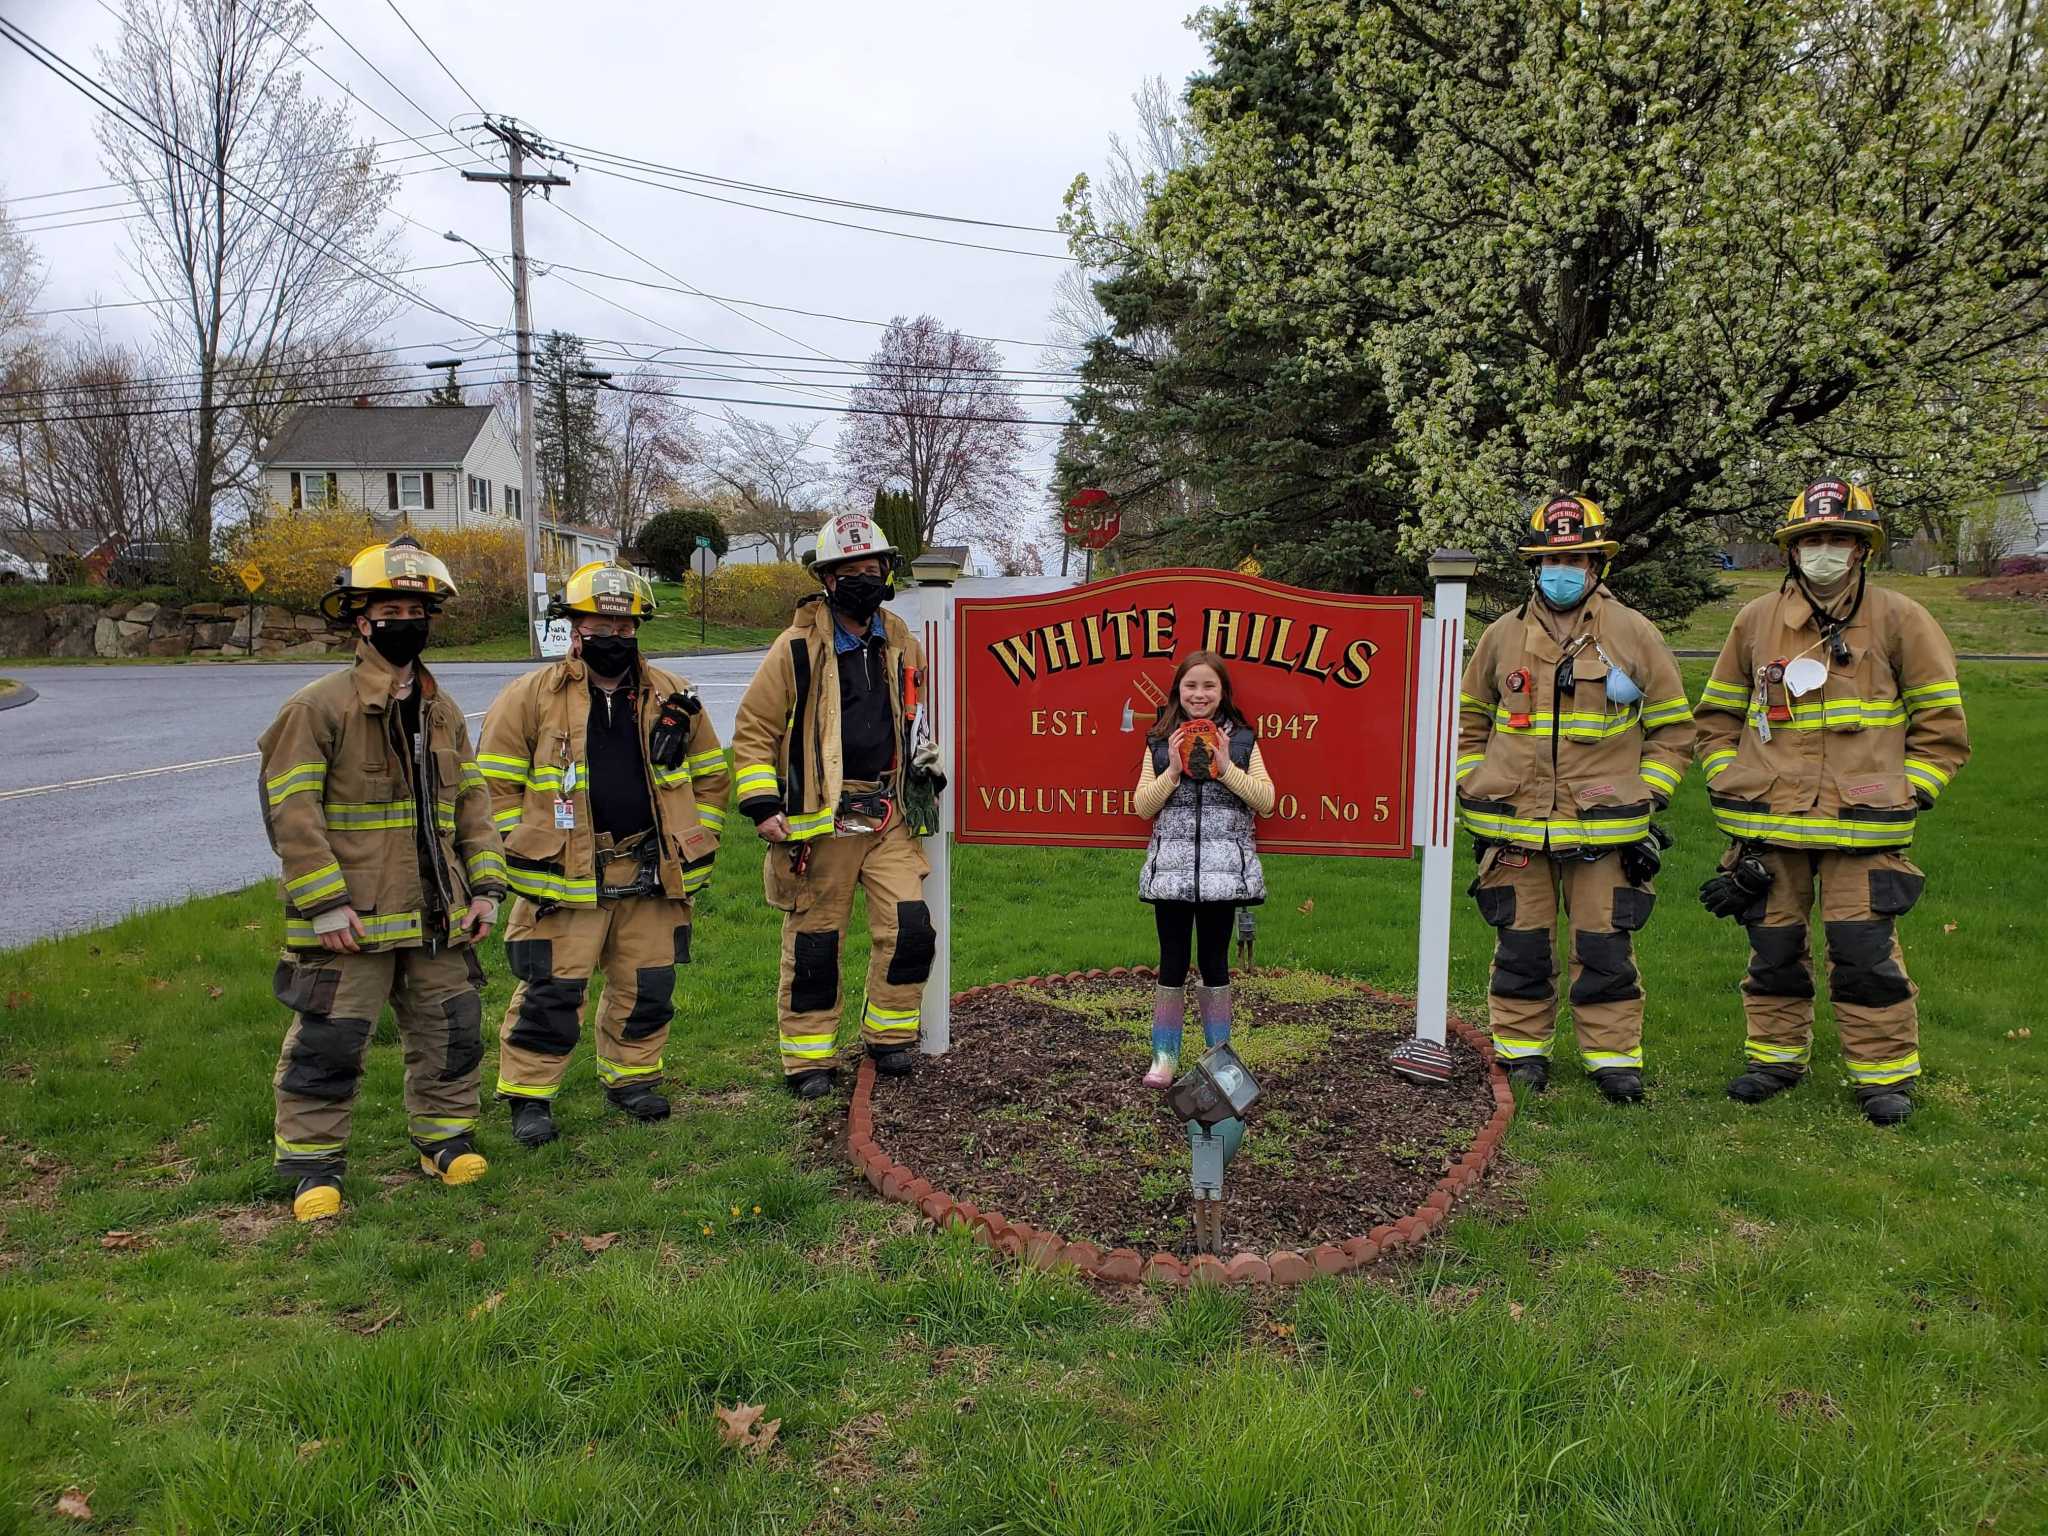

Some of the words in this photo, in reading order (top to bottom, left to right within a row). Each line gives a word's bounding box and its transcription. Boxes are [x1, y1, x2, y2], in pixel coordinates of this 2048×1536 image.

[1818, 498, 1831, 515] 5
[1068, 508, 1117, 531] OP
[1557, 518, 1570, 535] 5
[404, 560, 417, 578] 5
[608, 579, 621, 596] 5
[987, 603, 1178, 686] WHITE
[1203, 608, 1380, 688] HILLS
[1031, 709, 1097, 736] EST.
[1256, 713, 1320, 740] 1947
[978, 786, 1139, 816] VOLUNTEE
[1257, 793, 1308, 821] O.
[1320, 794, 1360, 822] No
[1373, 796, 1391, 822] 5
